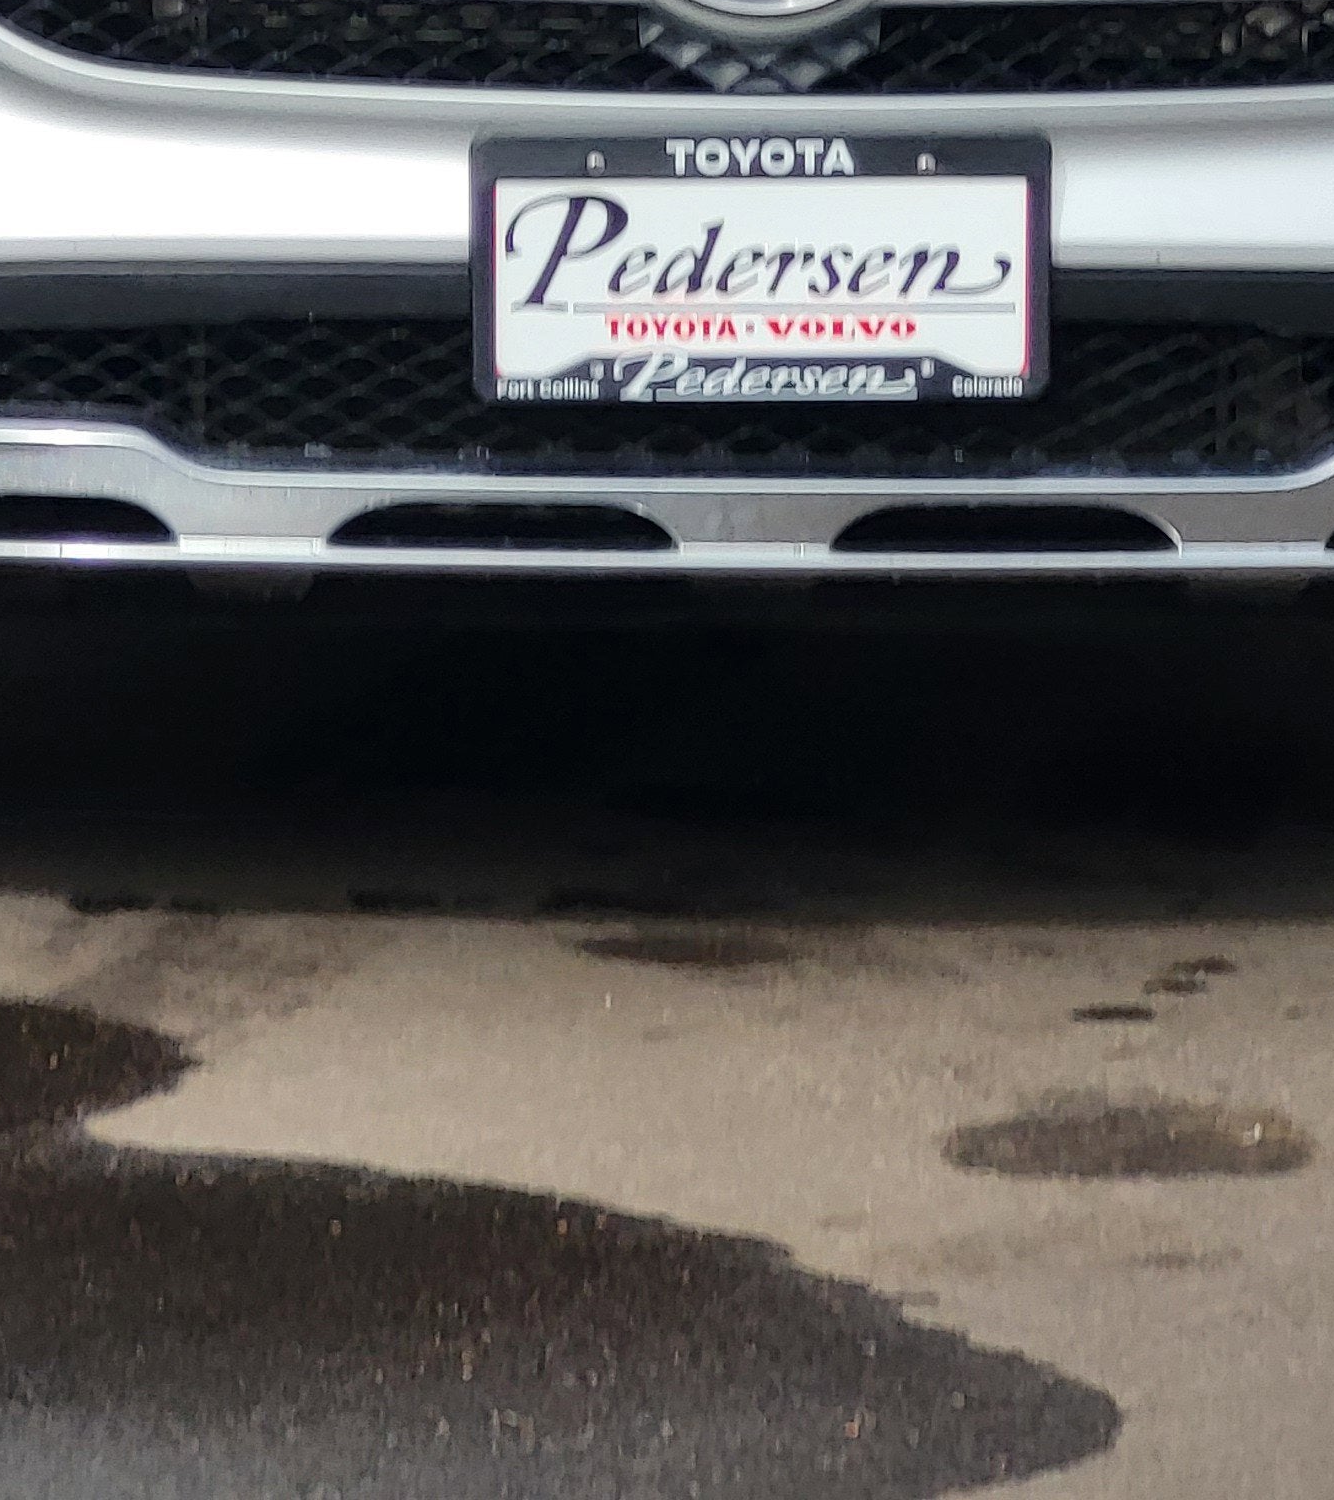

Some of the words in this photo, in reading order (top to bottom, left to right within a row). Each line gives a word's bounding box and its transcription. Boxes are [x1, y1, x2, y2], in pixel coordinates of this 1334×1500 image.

[666, 138, 856, 177] TOYOTA
[505, 193, 1013, 308] Pedersen
[606, 314, 738, 343] TOYOTA
[766, 315, 917, 342] VOLVO
[613, 348, 918, 398] Pedersen
